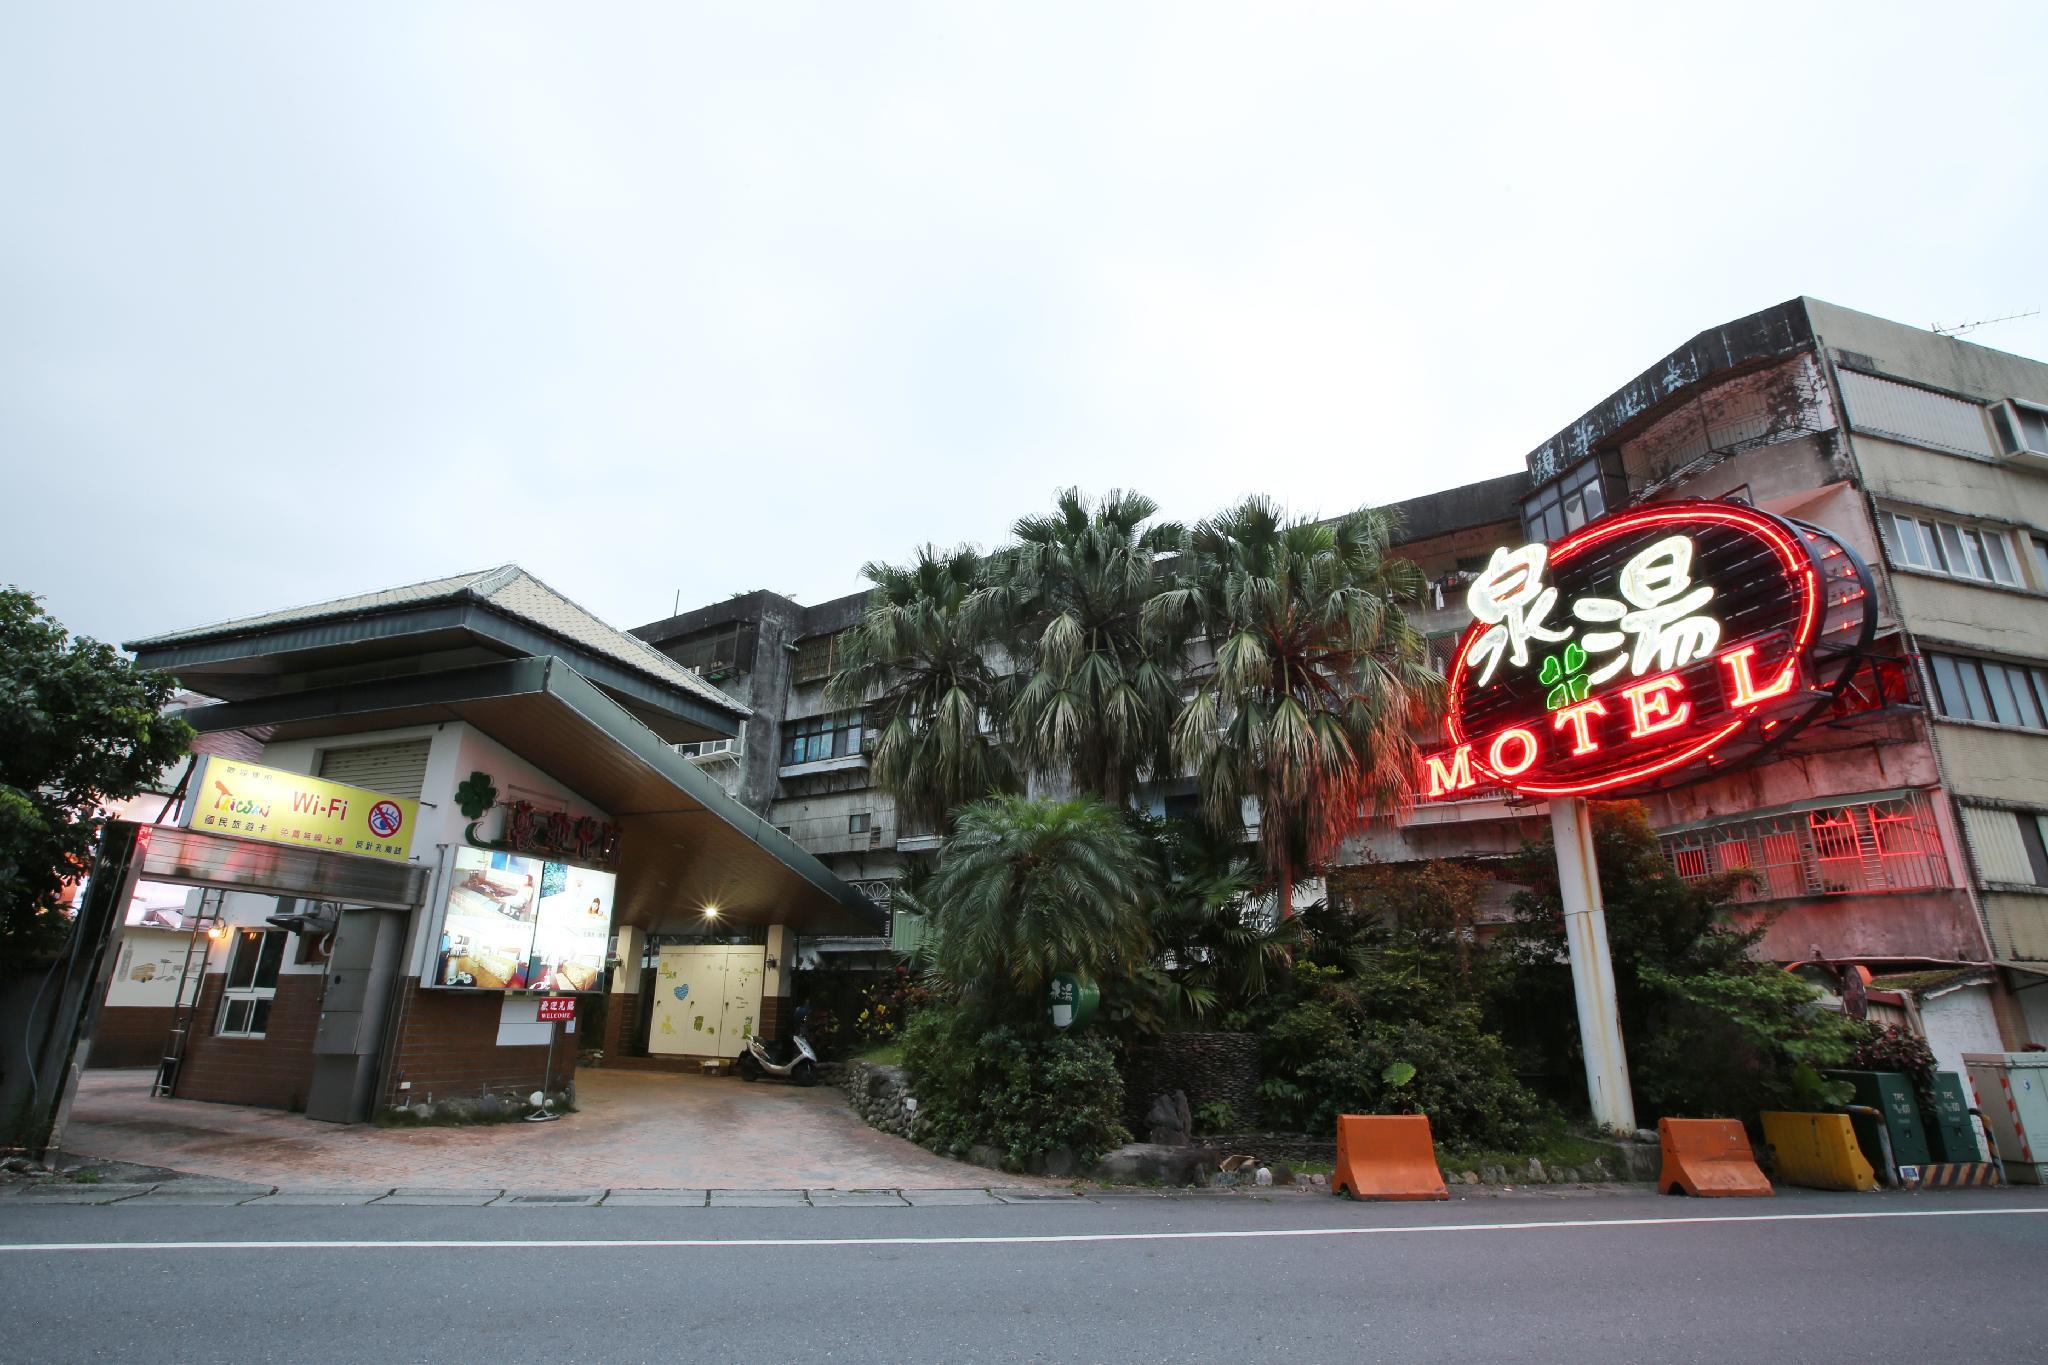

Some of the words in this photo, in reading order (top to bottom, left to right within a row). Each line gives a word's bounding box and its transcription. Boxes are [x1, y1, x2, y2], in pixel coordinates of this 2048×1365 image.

[1425, 646, 1795, 797] MOTEL
[293, 790, 348, 821] Wi-Fi
[205, 815, 267, 832] 國民旅遊卡
